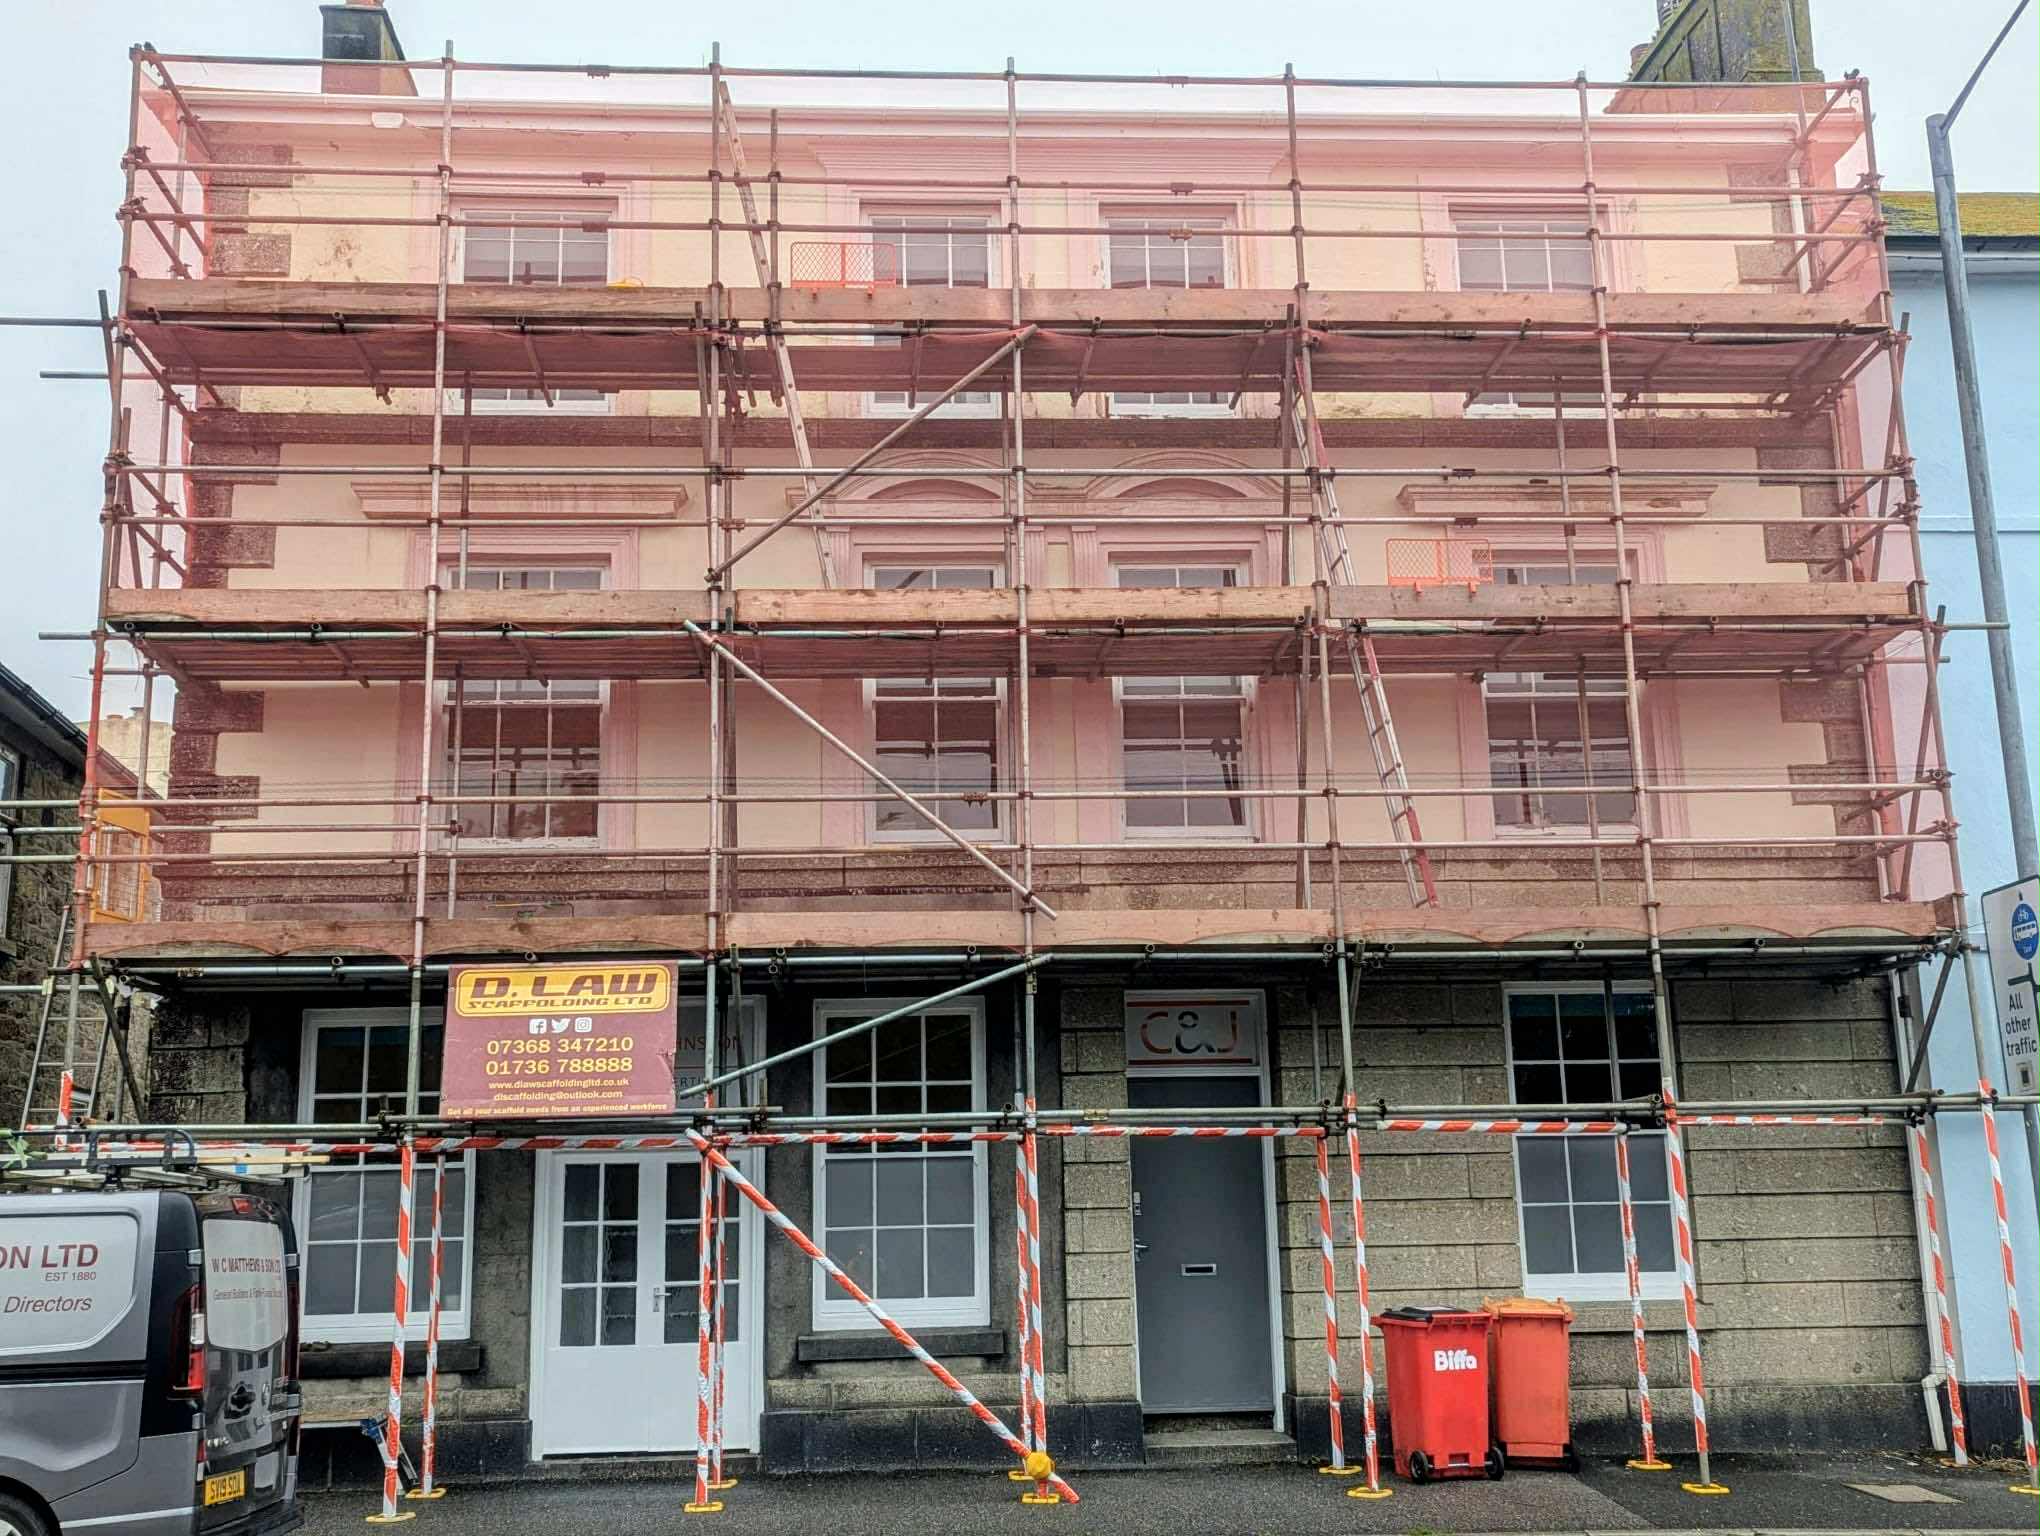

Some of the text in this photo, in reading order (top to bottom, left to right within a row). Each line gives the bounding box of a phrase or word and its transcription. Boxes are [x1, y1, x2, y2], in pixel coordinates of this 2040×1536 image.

[470, 973, 660, 999] D. LAW
[467, 996, 652, 1010] SCAFFOLDING LTD
[2009, 992, 2023, 1011] All
[2005, 1016, 2031, 1035] other
[487, 1036, 634, 1055] 07368 347210
[2006, 1037, 2037, 1056] traffic
[485, 1057, 633, 1076] 01736 788888
[447, 1107, 461, 1116] Get
[494, 1104, 522, 1114] scaffold
[526, 1104, 549, 1114] needs
[551, 1103, 569, 1113] from
[571, 1104, 582, 1112] an
[583, 1102, 628, 1113] experienced
[630, 1101, 667, 1111] workforce
[41, 1244, 99, 1268] LTD
[212, 1258, 220, 1273] W
[221, 1258, 227, 1273] C
[45, 1271, 96, 1282] EST 1880
[3, 1296, 93, 1313] Directors
[1433, 1349, 1477, 1372] Biffa
